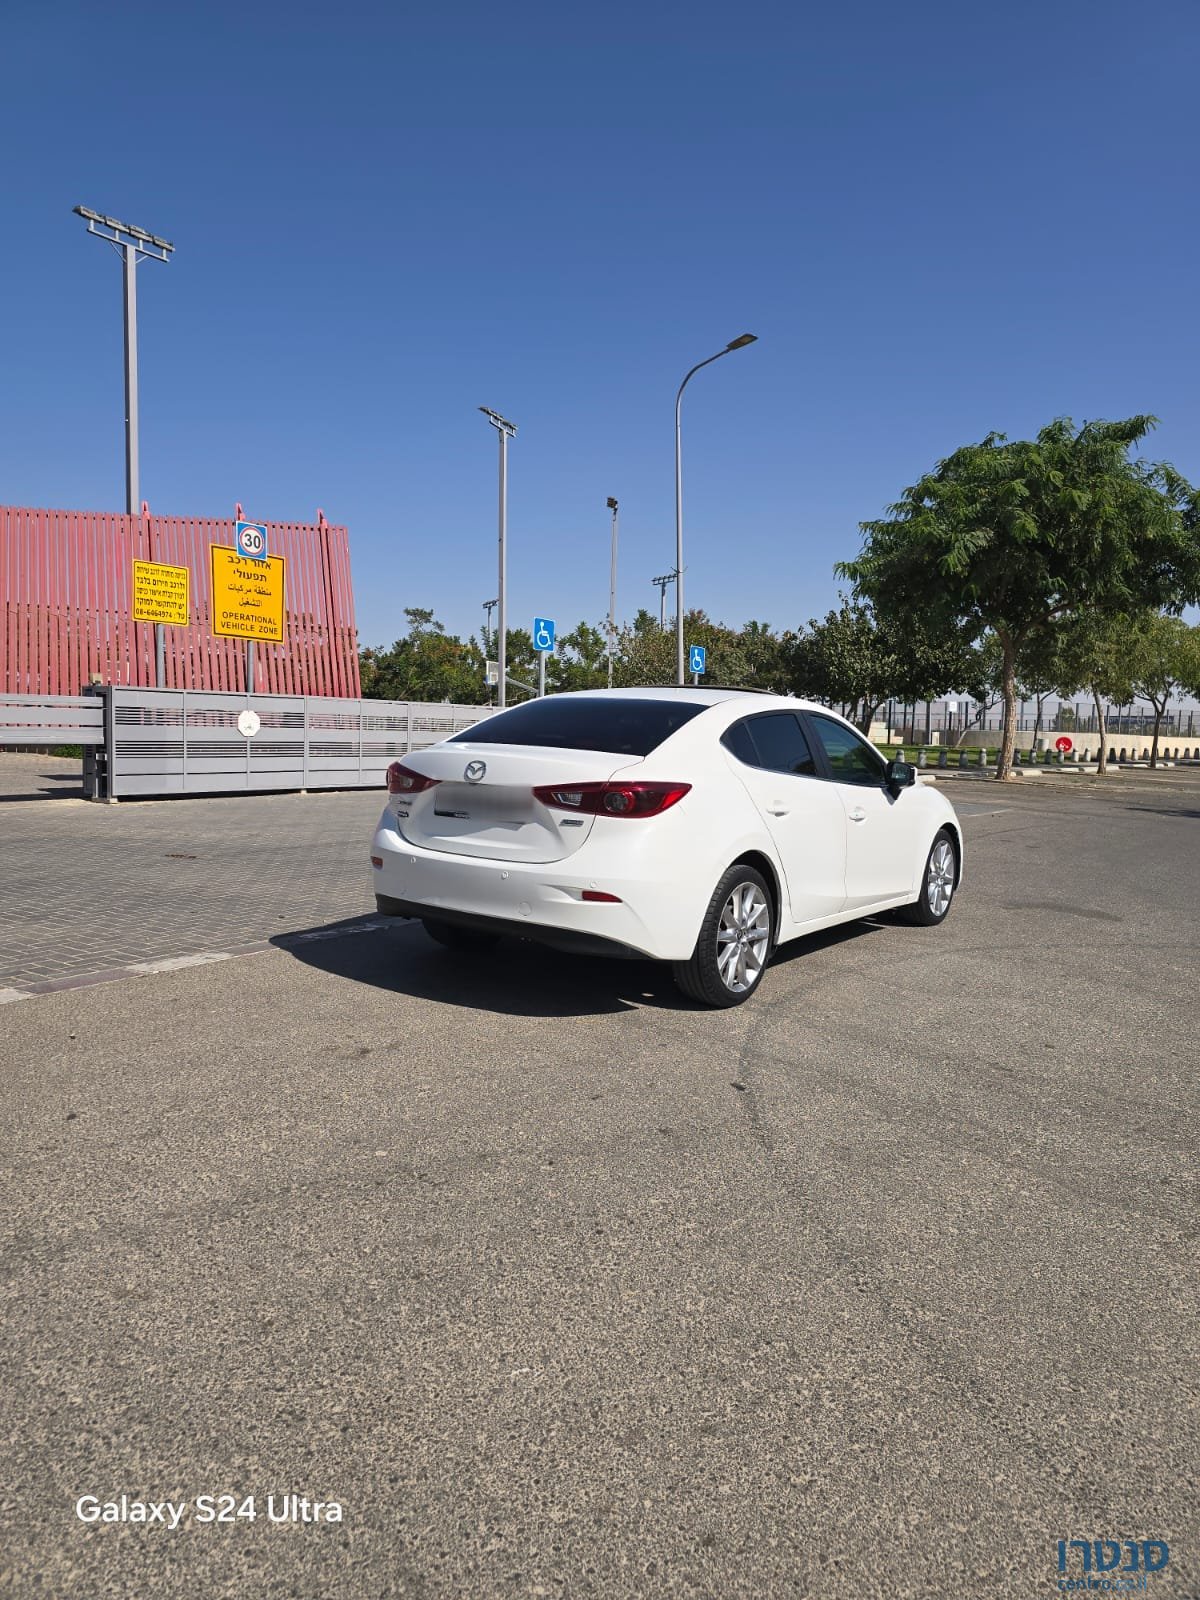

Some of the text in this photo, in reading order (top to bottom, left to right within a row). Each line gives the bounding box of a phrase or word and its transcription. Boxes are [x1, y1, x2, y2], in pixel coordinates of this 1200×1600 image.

[244, 533, 261, 549] 30
[227, 555, 271, 570] אזור רכב
[136, 576, 151, 585] בלבד
[233, 568, 267, 582] תפעולי
[152, 578, 169, 587] חירום
[228, 583, 272, 596] منطقة مركبات
[135, 597, 154, 606] למוקד
[178, 602, 185, 610] יש
[222, 611, 277, 625] OPERATIONAL
[221, 621, 278, 635] VEHICLE ZONE
